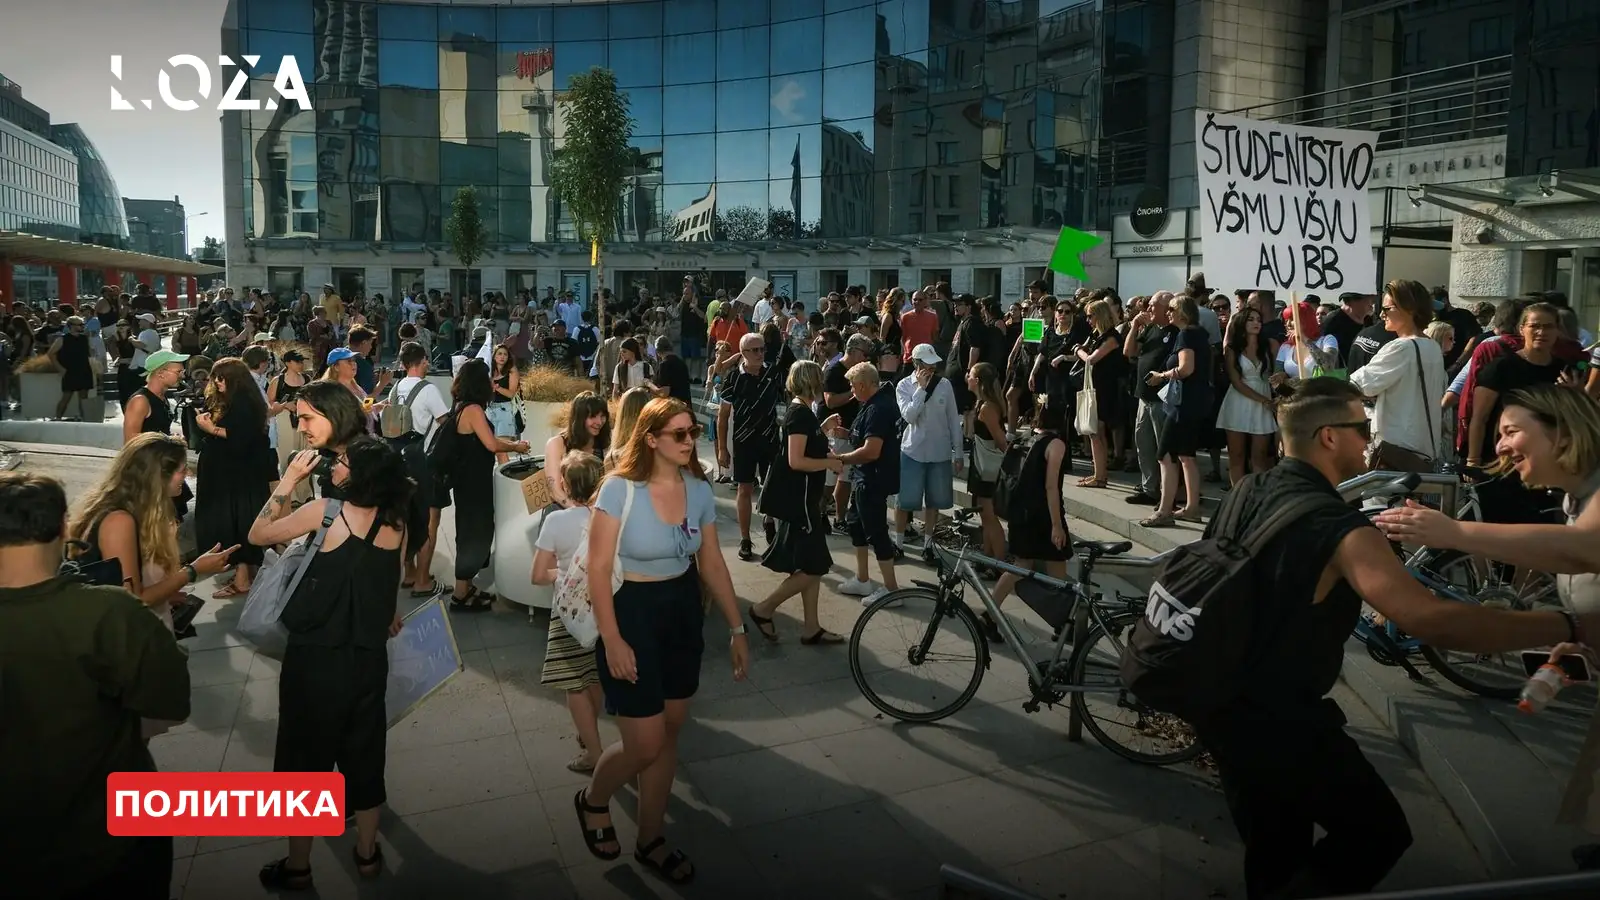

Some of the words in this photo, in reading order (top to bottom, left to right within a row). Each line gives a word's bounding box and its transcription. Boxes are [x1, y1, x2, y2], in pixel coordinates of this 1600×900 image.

[1202, 112, 1374, 190] ŠTUDENTSTVO
[1409, 152, 1503, 175] DIVADLO
[1136, 206, 1163, 216] ČINOHRA
[1207, 181, 1285, 235] VŠMU
[1294, 190, 1357, 244] VŠVU
[1132, 244, 1164, 253] SLOVENSKÉ
[1256, 242, 1296, 289] AU
[1302, 244, 1344, 290] BB
